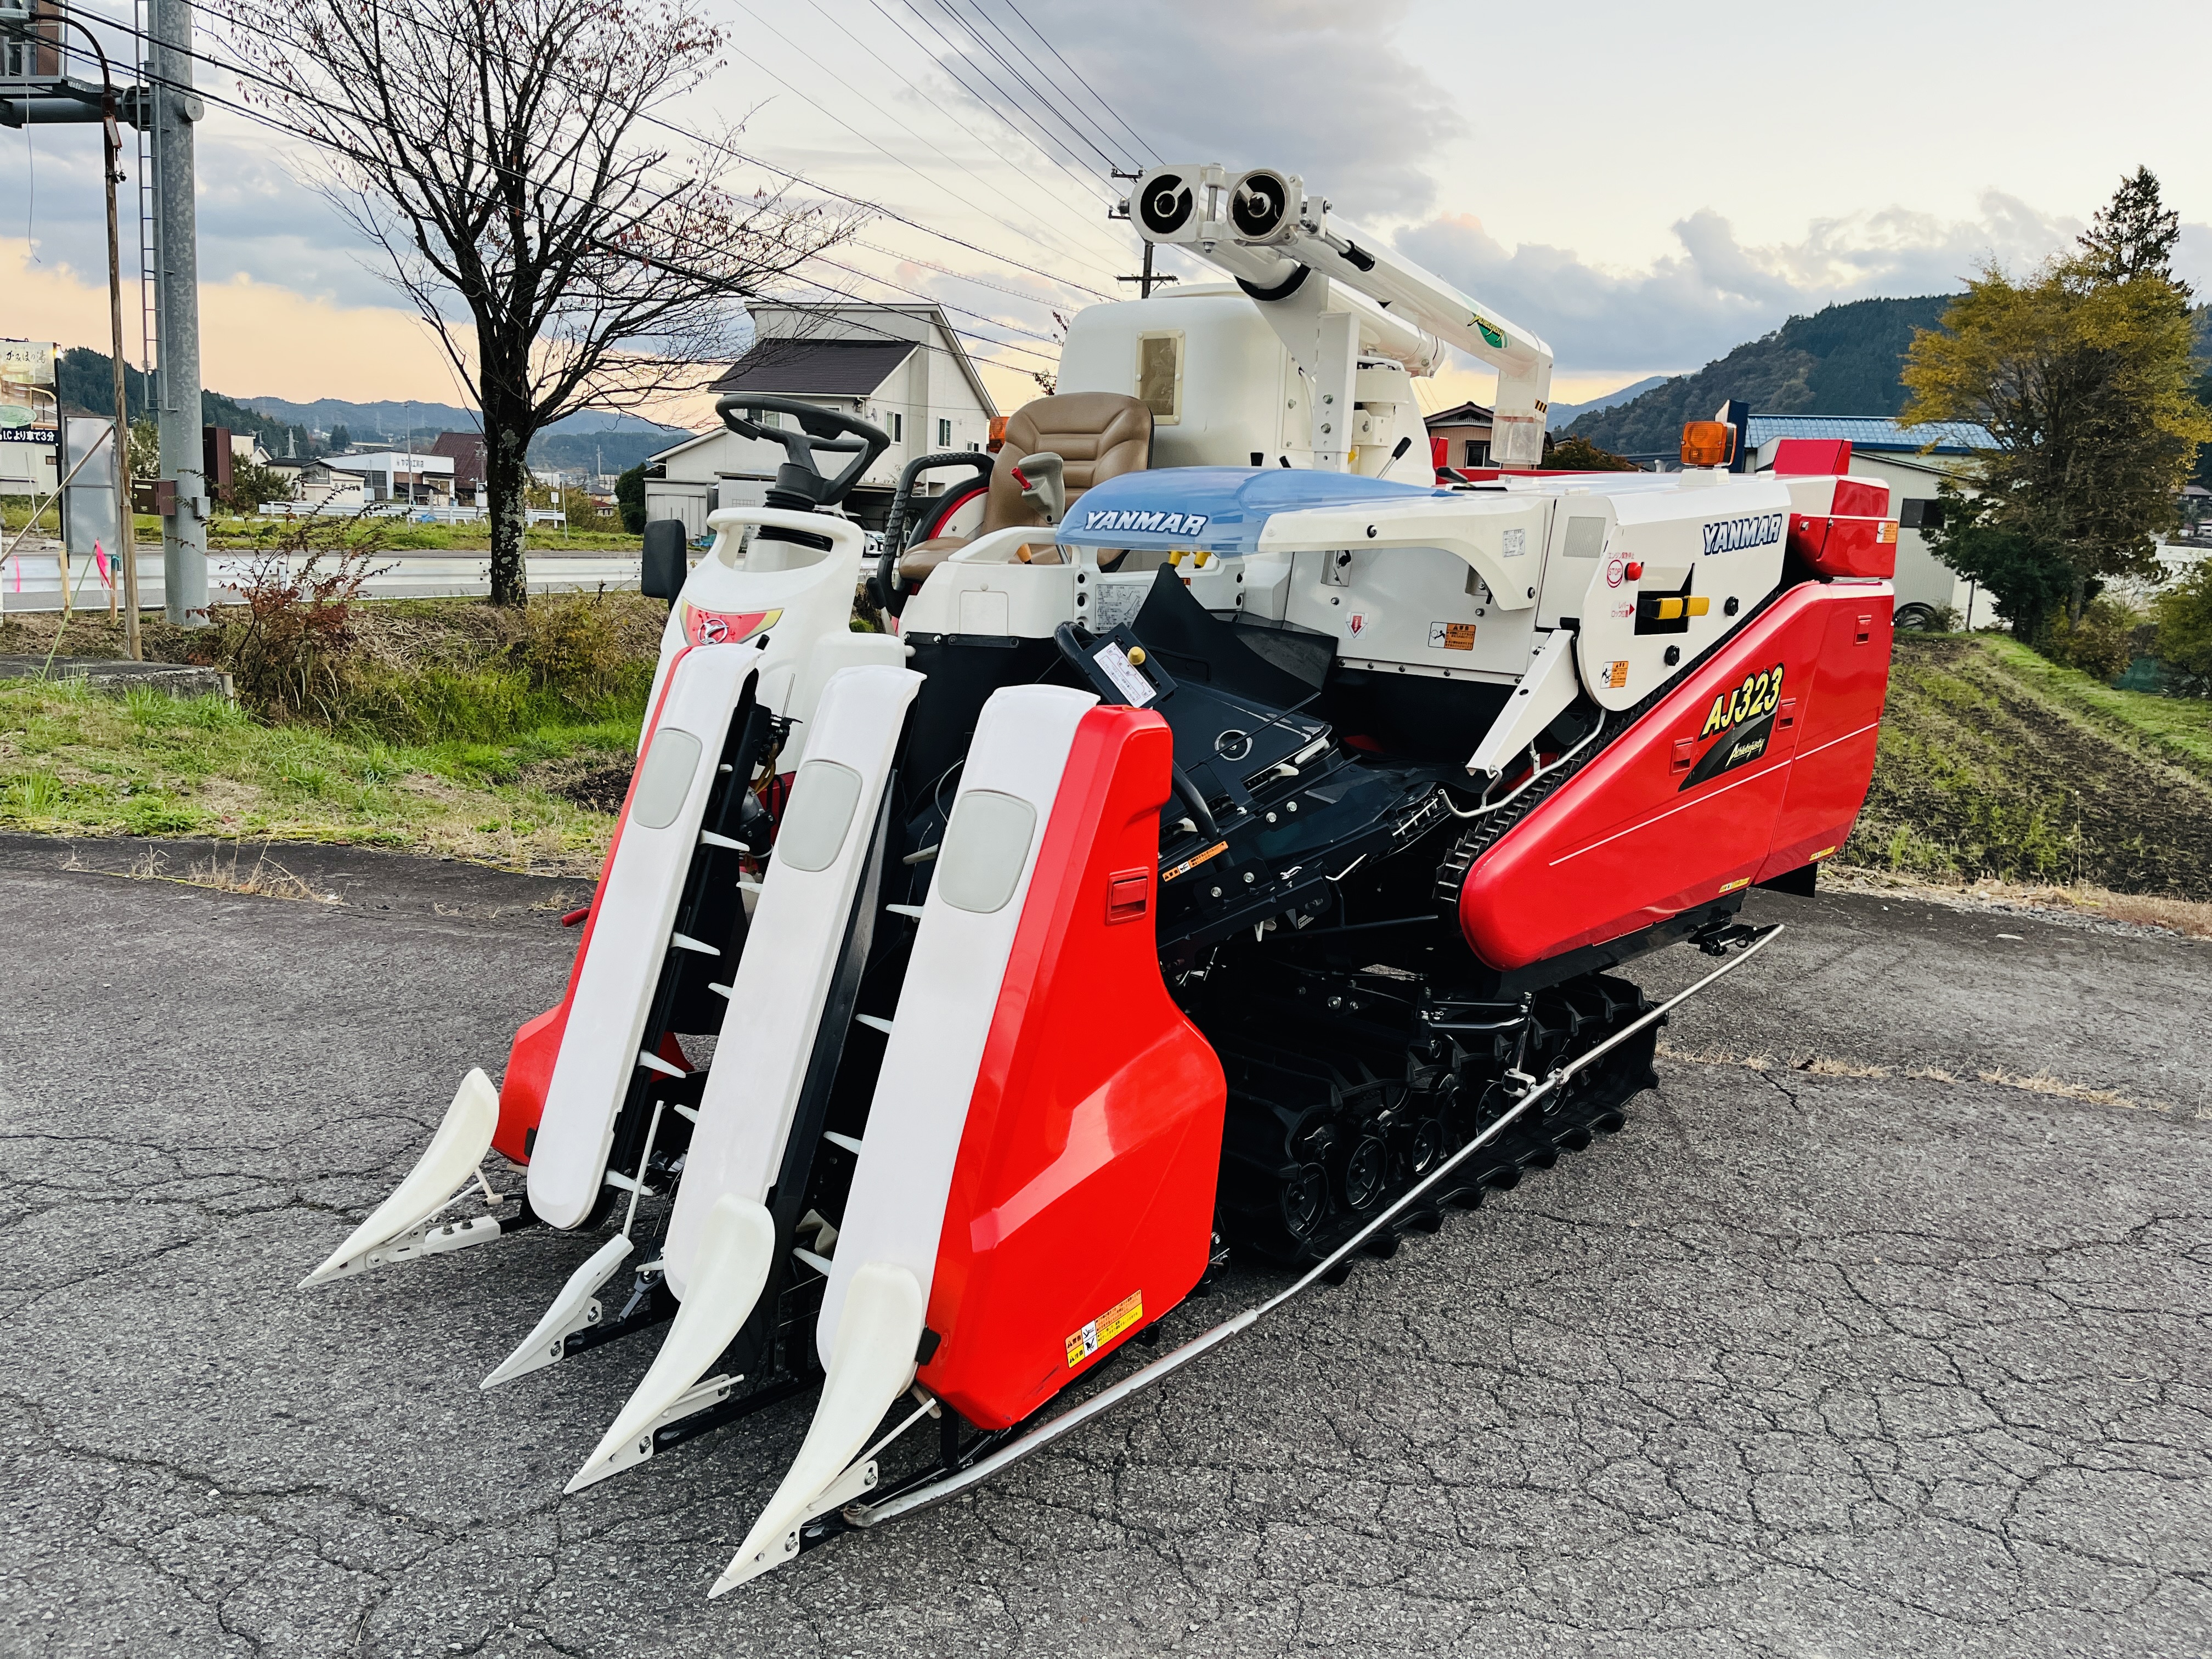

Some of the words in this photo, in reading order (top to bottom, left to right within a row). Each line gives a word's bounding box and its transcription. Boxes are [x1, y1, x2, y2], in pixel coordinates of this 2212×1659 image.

[1084, 510, 1209, 537] YANMAR
[1703, 514, 1782, 556] YANMAR
[1697, 663, 1784, 742] AJ323
